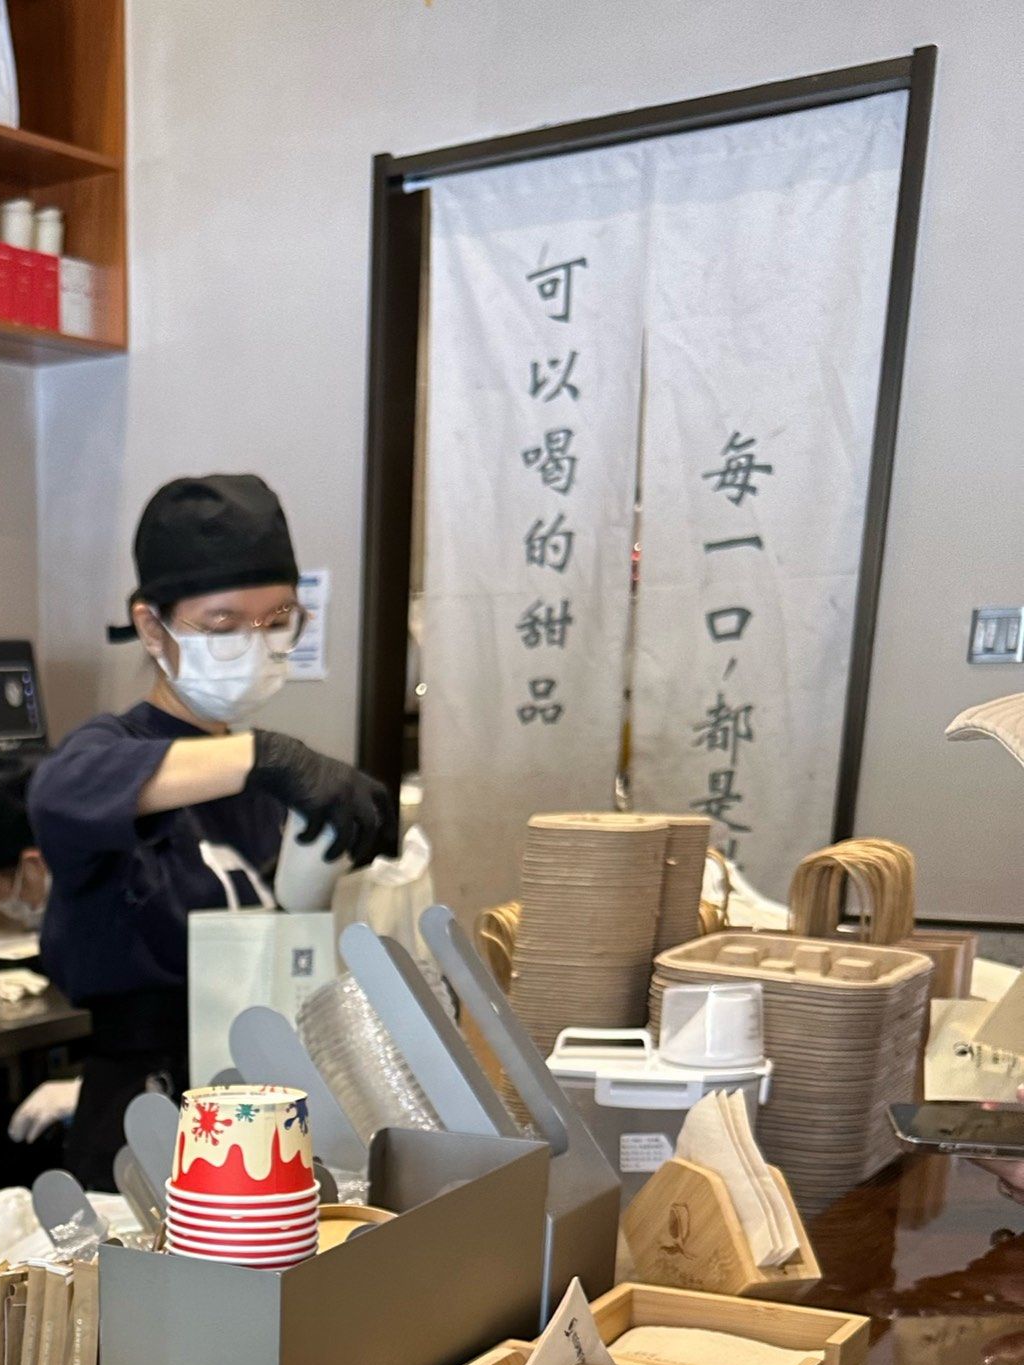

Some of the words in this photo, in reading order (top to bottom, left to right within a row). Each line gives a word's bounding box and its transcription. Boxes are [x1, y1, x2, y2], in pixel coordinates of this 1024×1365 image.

[516, 257, 588, 727] 可以喝的甜品
